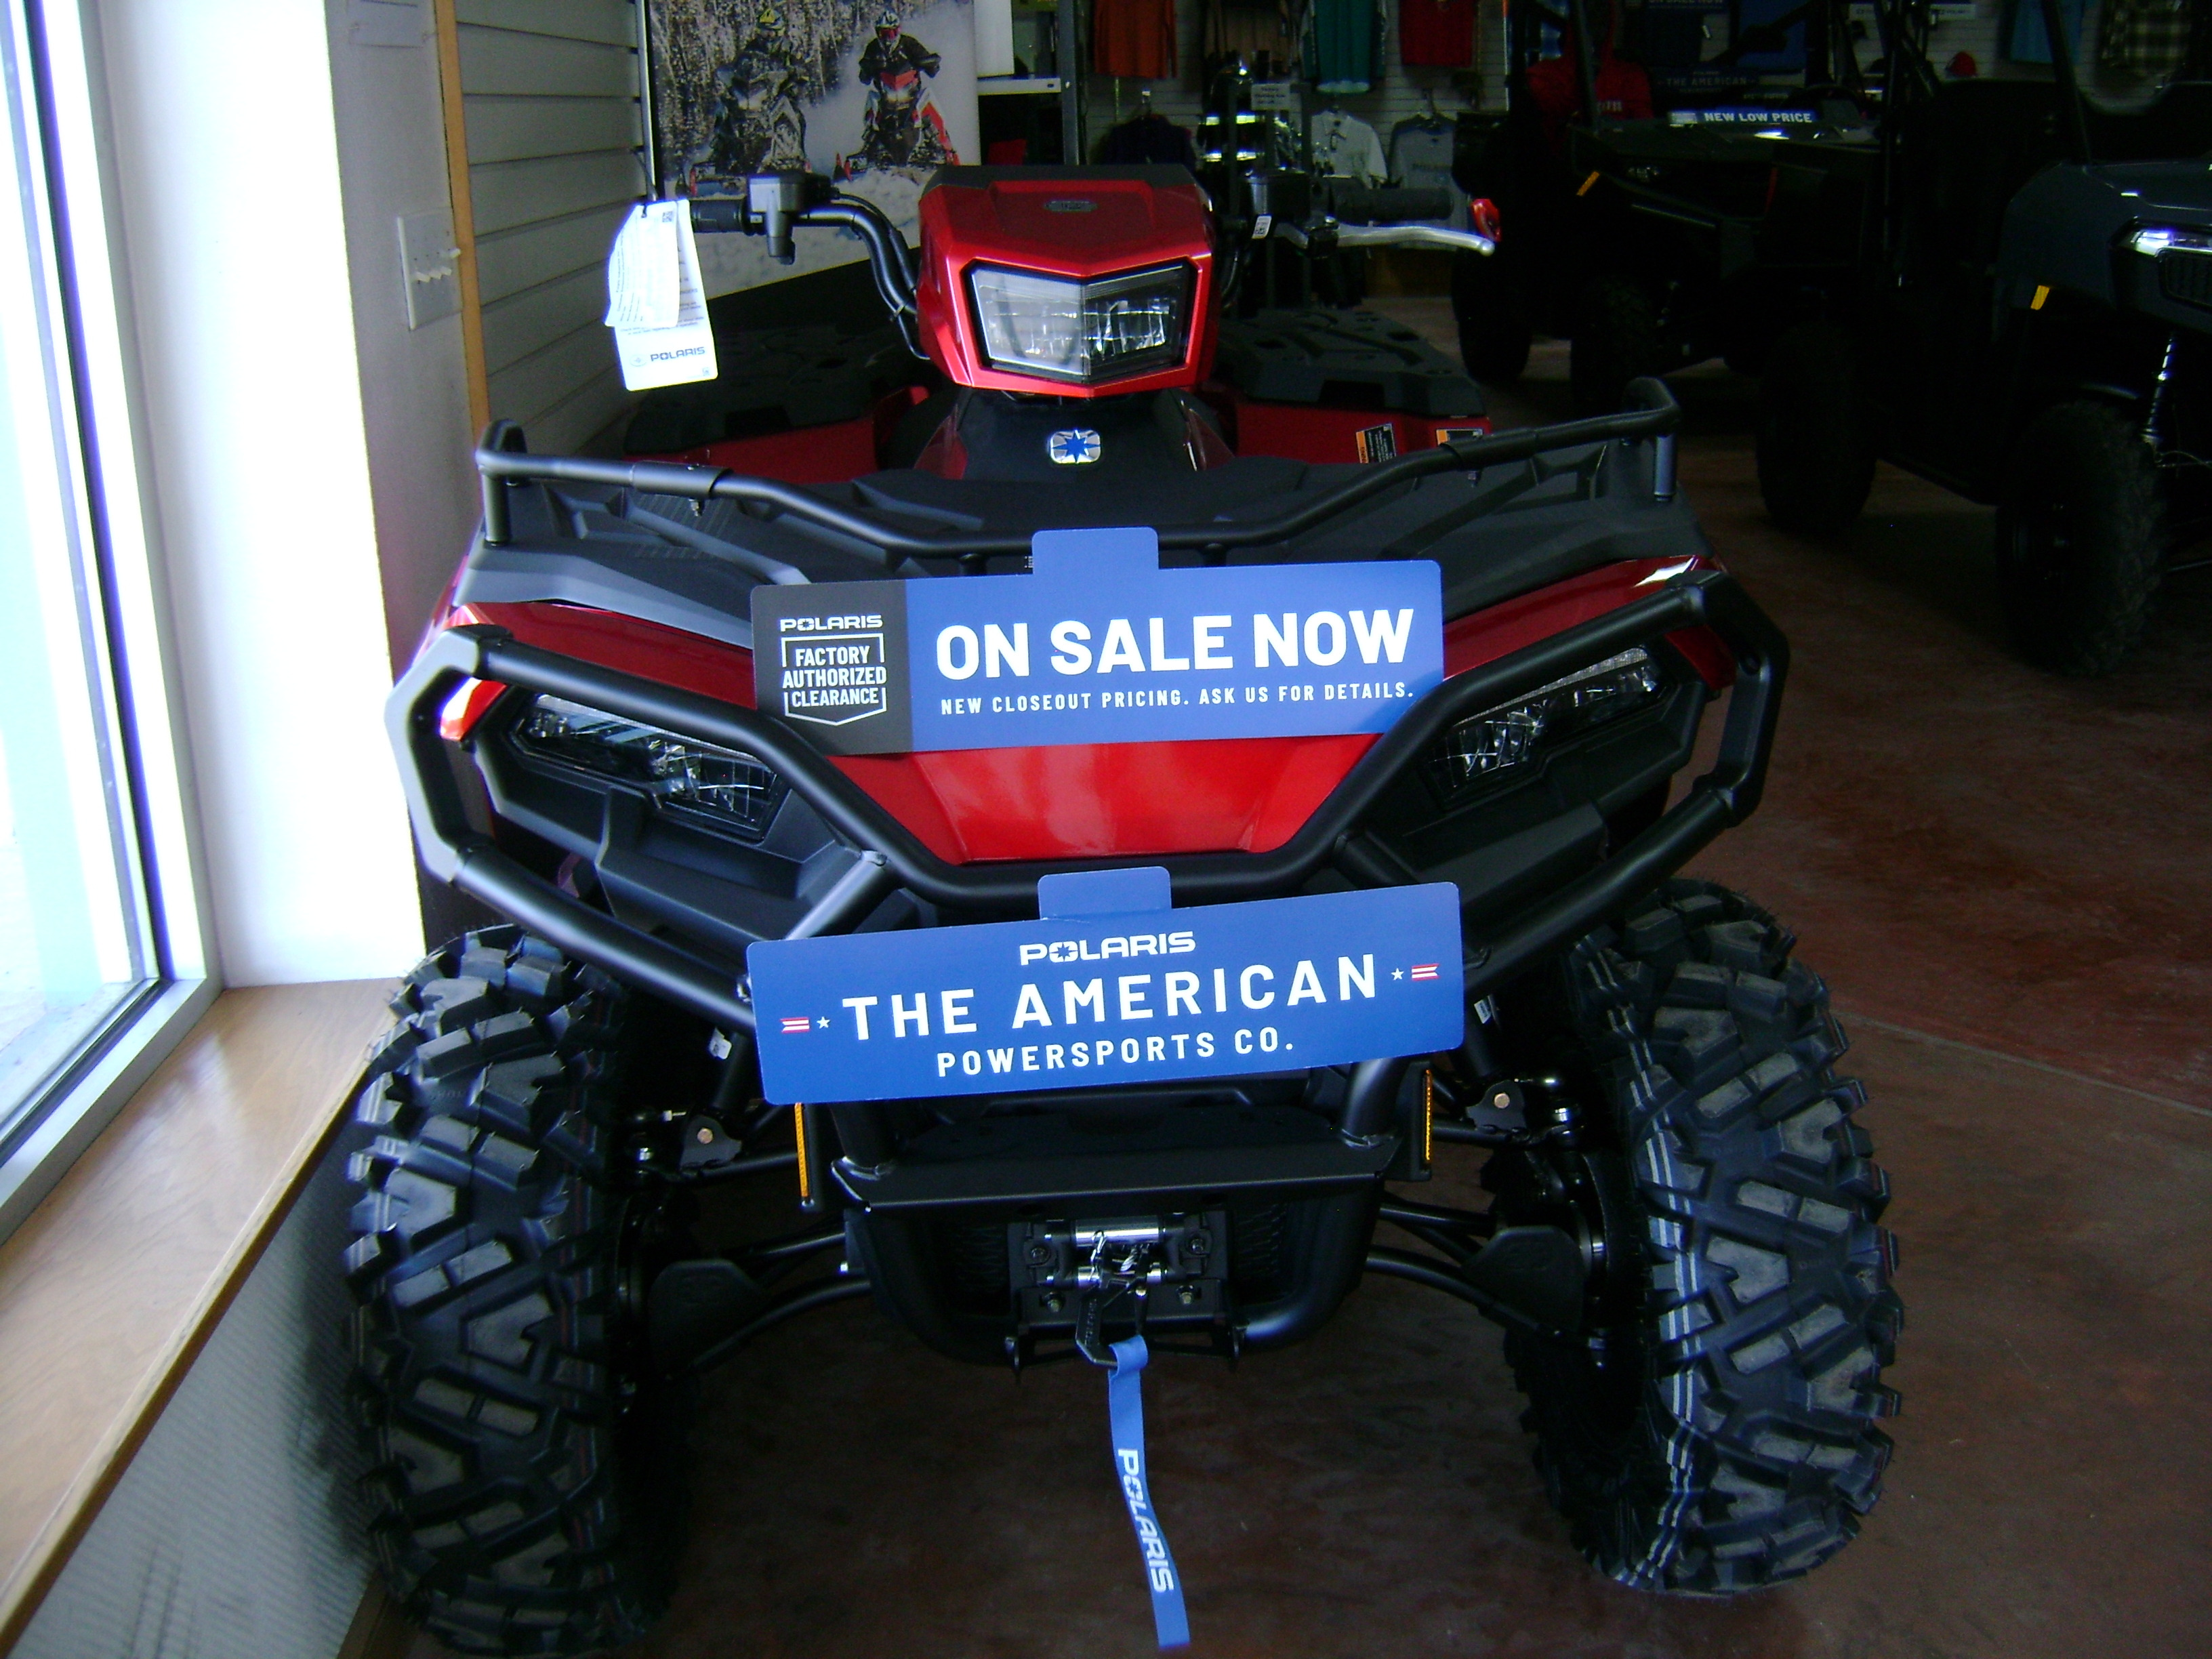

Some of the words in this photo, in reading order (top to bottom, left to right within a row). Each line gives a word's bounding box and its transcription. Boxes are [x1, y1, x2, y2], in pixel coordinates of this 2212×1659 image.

[1704, 112, 1735, 122] NEW
[1738, 112, 1768, 123] LOW
[1771, 112, 1812, 123] PRICE
[651, 347, 705, 361] POLARIS
[781, 615, 883, 632] POLARIS
[796, 646, 870, 666] FACTORY
[937, 623, 1029, 680] ON
[1050, 615, 1233, 674] SALE
[1254, 609, 1414, 667] NOW
[783, 667, 886, 689] AUTHORIZED
[792, 688, 878, 707] CLEARANCE
[942, 698, 981, 714] NEW
[993, 693, 1090, 712] CLOSEOUT
[1102, 690, 1188, 708] PRICING.
[1200, 688, 1234, 704] ASK
[1246, 687, 1268, 703] US
[1279, 685, 1313, 701] FOR
[1325, 682, 1412, 699] DETAILS.
[1020, 932, 1195, 965] POLARIS
[842, 989, 977, 1040] THE
[1012, 954, 1374, 1028] AMERICAN
[938, 1033, 1214, 1076] POWERSPORTS
[1235, 1027, 1292, 1054] CO.
[1118, 1450, 1173, 1591] POLARIS
